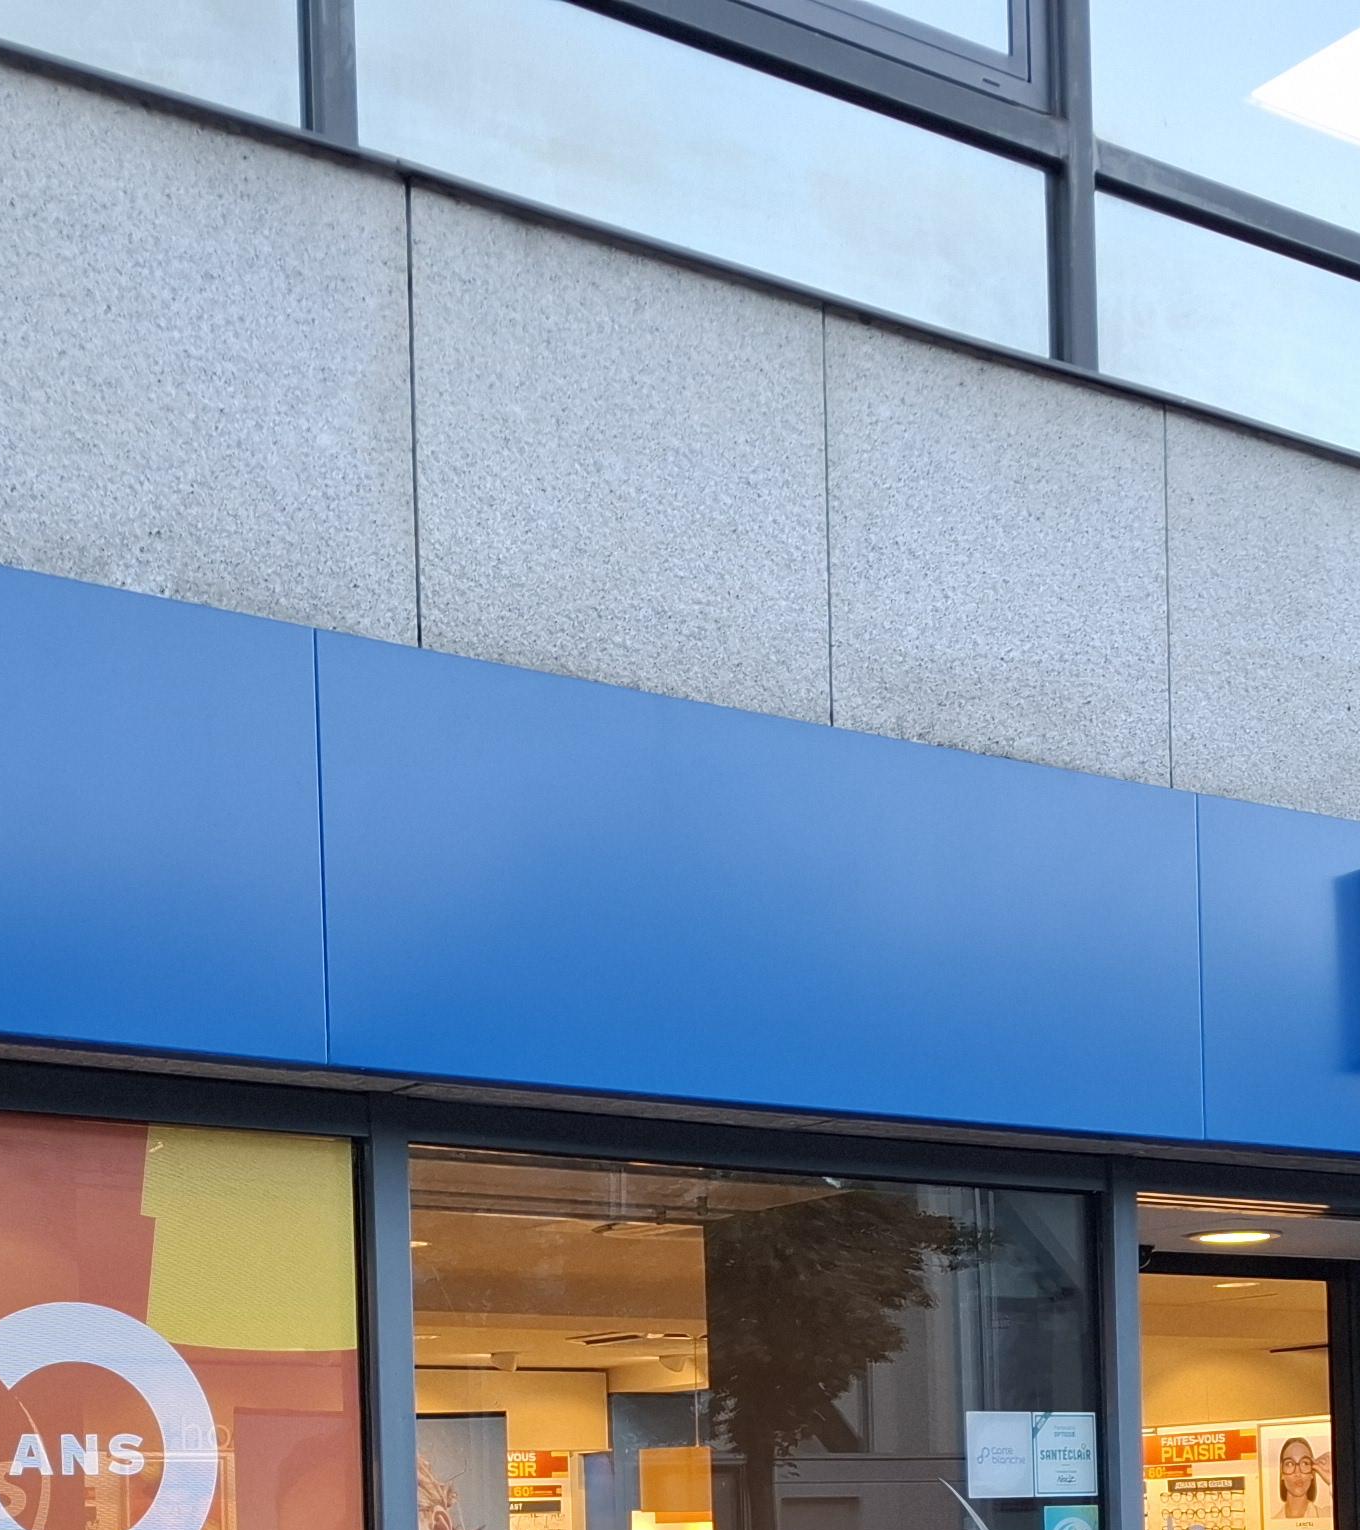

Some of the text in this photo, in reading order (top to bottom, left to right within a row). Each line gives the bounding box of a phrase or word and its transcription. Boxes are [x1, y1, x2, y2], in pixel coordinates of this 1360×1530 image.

[1160, 1433, 1226, 1447] FAITES-VOUS
[9, 1433, 146, 1476] ANS
[1160, 1444, 1226, 1463] PLAISIR
